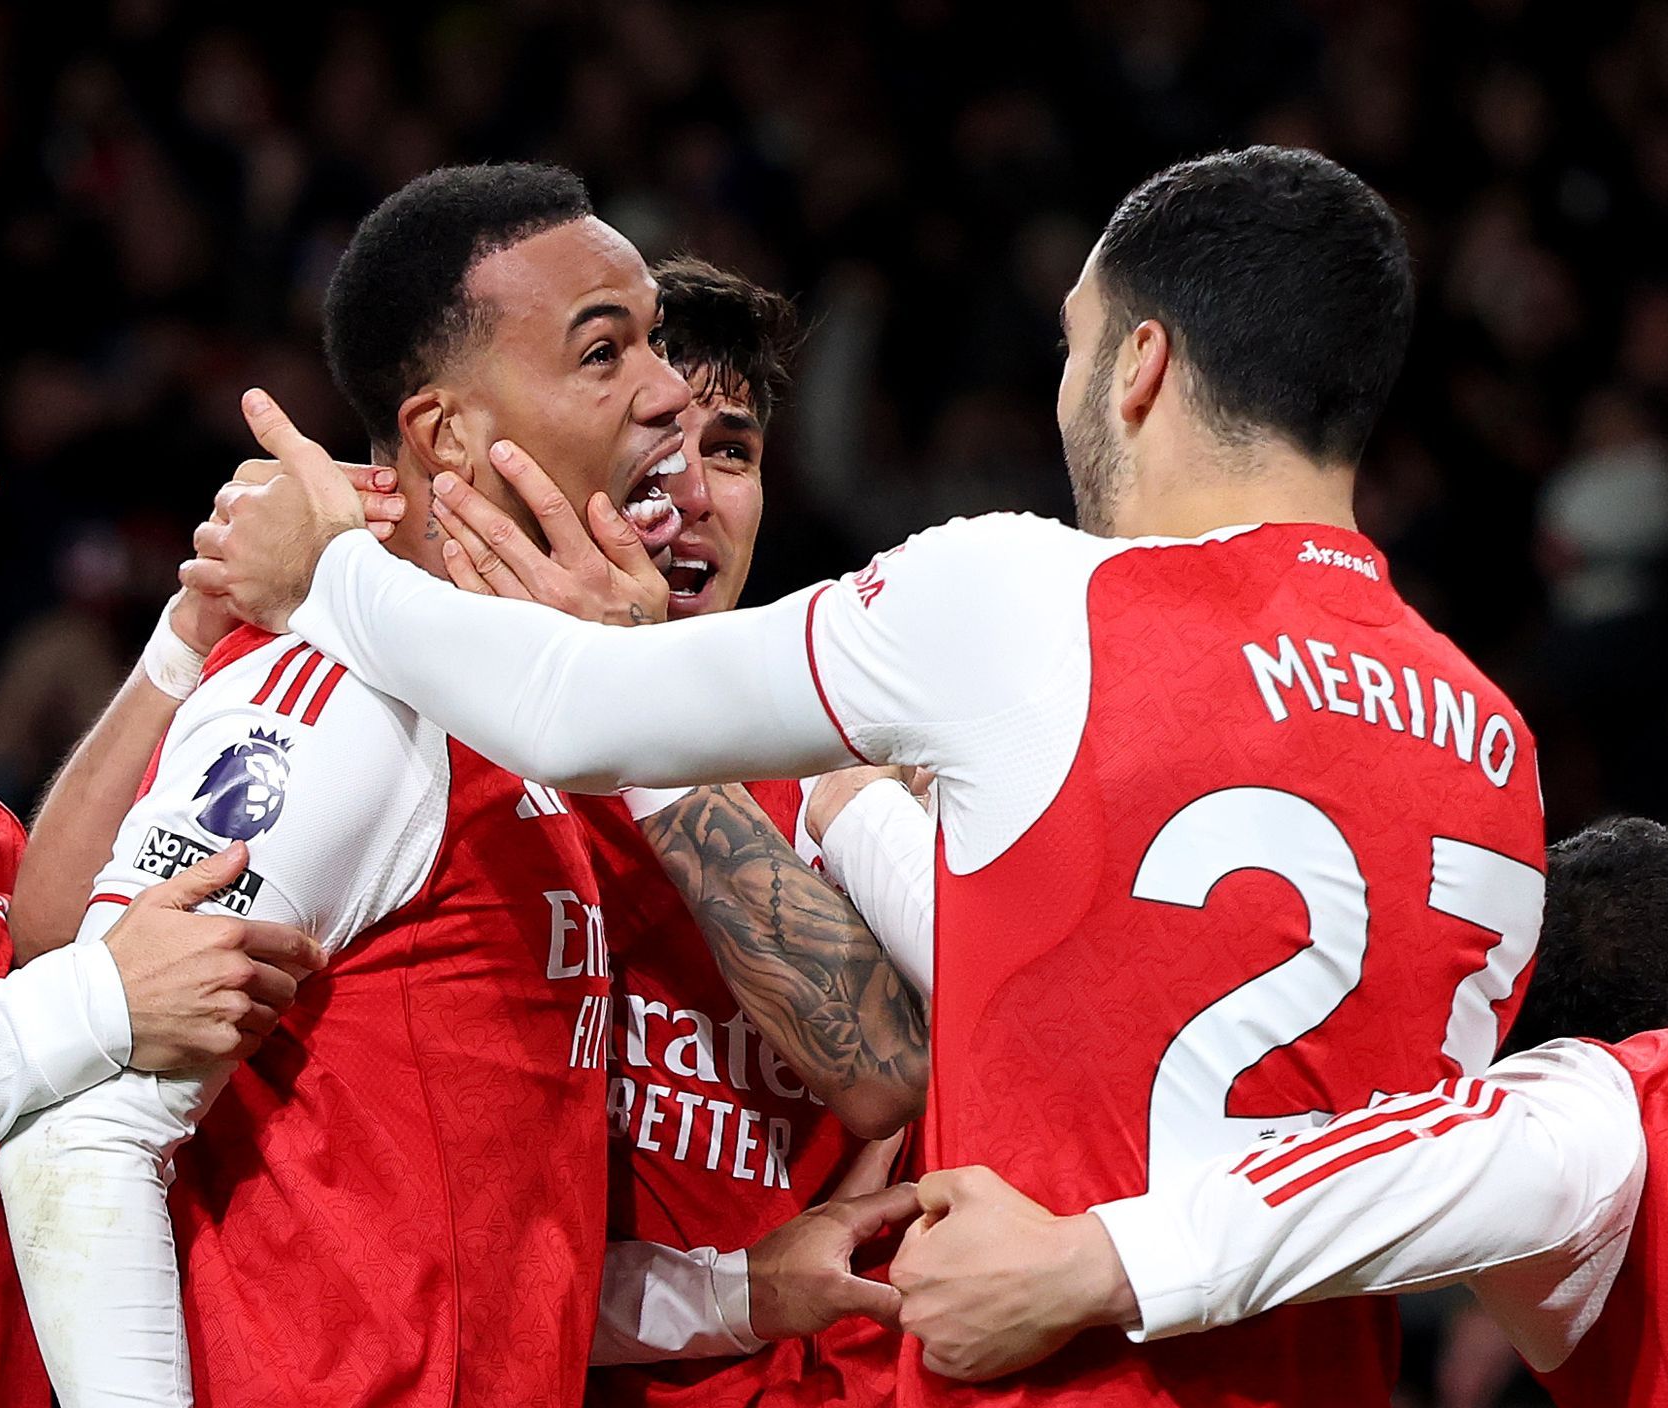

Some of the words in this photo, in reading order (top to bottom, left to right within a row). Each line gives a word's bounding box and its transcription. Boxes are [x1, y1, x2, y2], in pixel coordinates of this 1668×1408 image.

[1297, 540, 1380, 581] Arsenal
[1241, 633, 1517, 789] MERINO
[144, 827, 181, 858] No
[1132, 786, 1546, 1196] 27
[607, 1077, 796, 1190] BETTER
